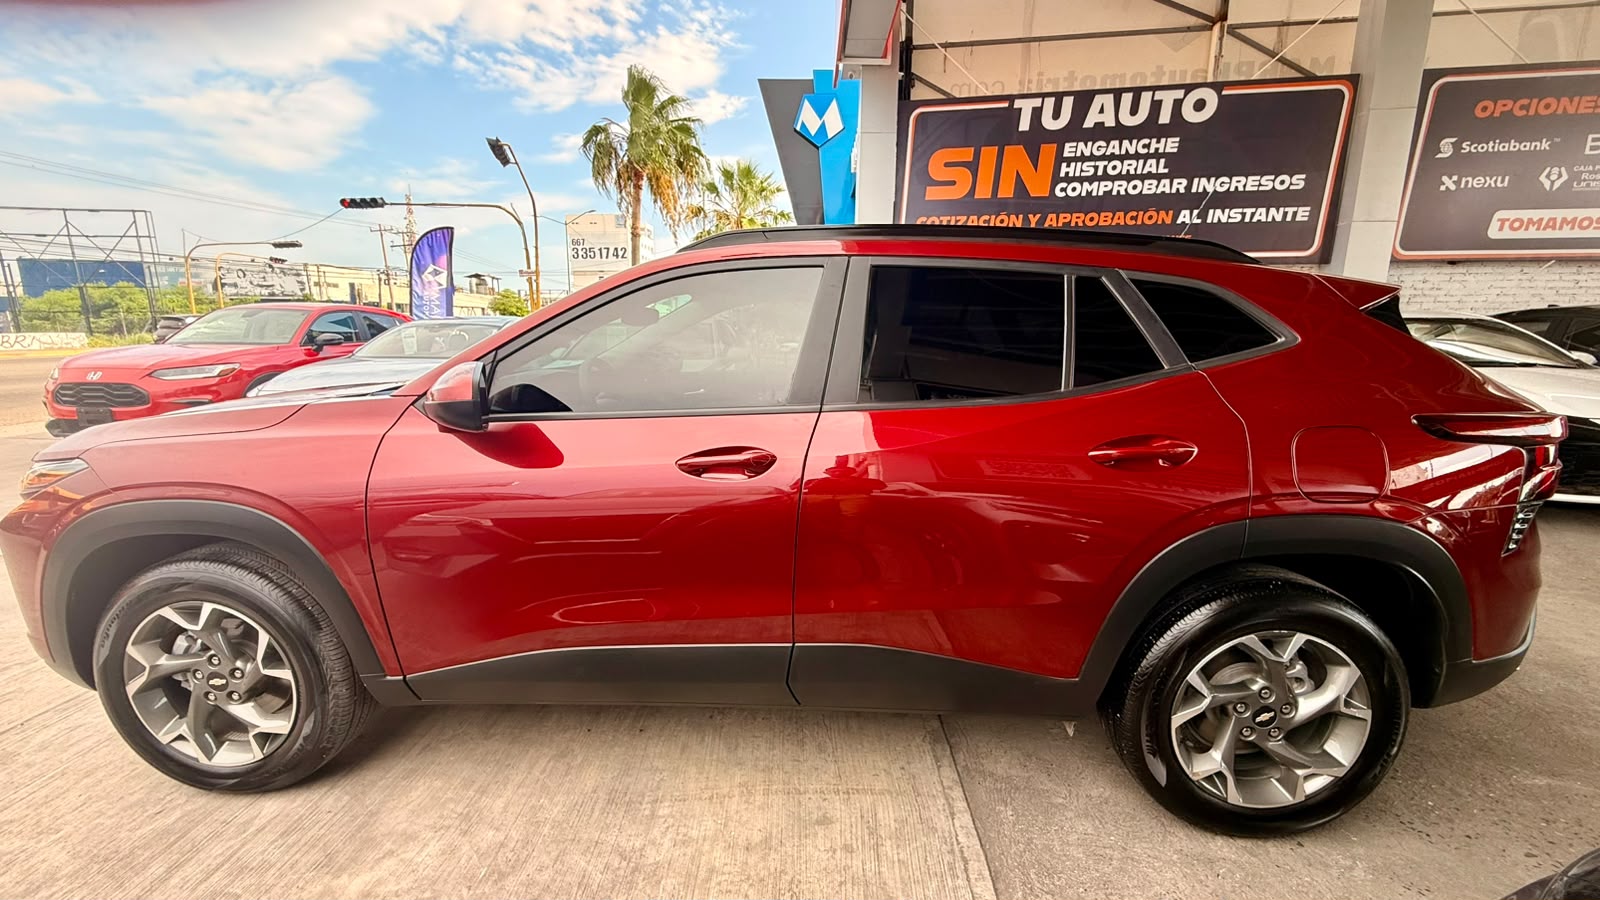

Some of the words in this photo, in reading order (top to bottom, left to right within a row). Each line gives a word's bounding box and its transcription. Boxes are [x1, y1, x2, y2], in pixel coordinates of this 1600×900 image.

[1014, 95, 1074, 131] TU
[1082, 87, 1219, 128] AUTO
[1063, 137, 1180, 157] ENGANCHE
[1461, 138, 1552, 153] Scotiabank
[925, 143, 1057, 200] SIN
[1060, 158, 1169, 177] HISTORIAL
[1055, 178, 1188, 197] COMPROBAR
[1191, 175, 1307, 193] INGRESOS
[1460, 175, 1510, 189] nexu
[1028, 213, 1041, 227] Y
[1044, 208, 1173, 227] APROBACIÓN
[1176, 210, 1202, 224] AL
[1206, 206, 1311, 224] INSTANTE
[571, 238, 585, 247] 667
